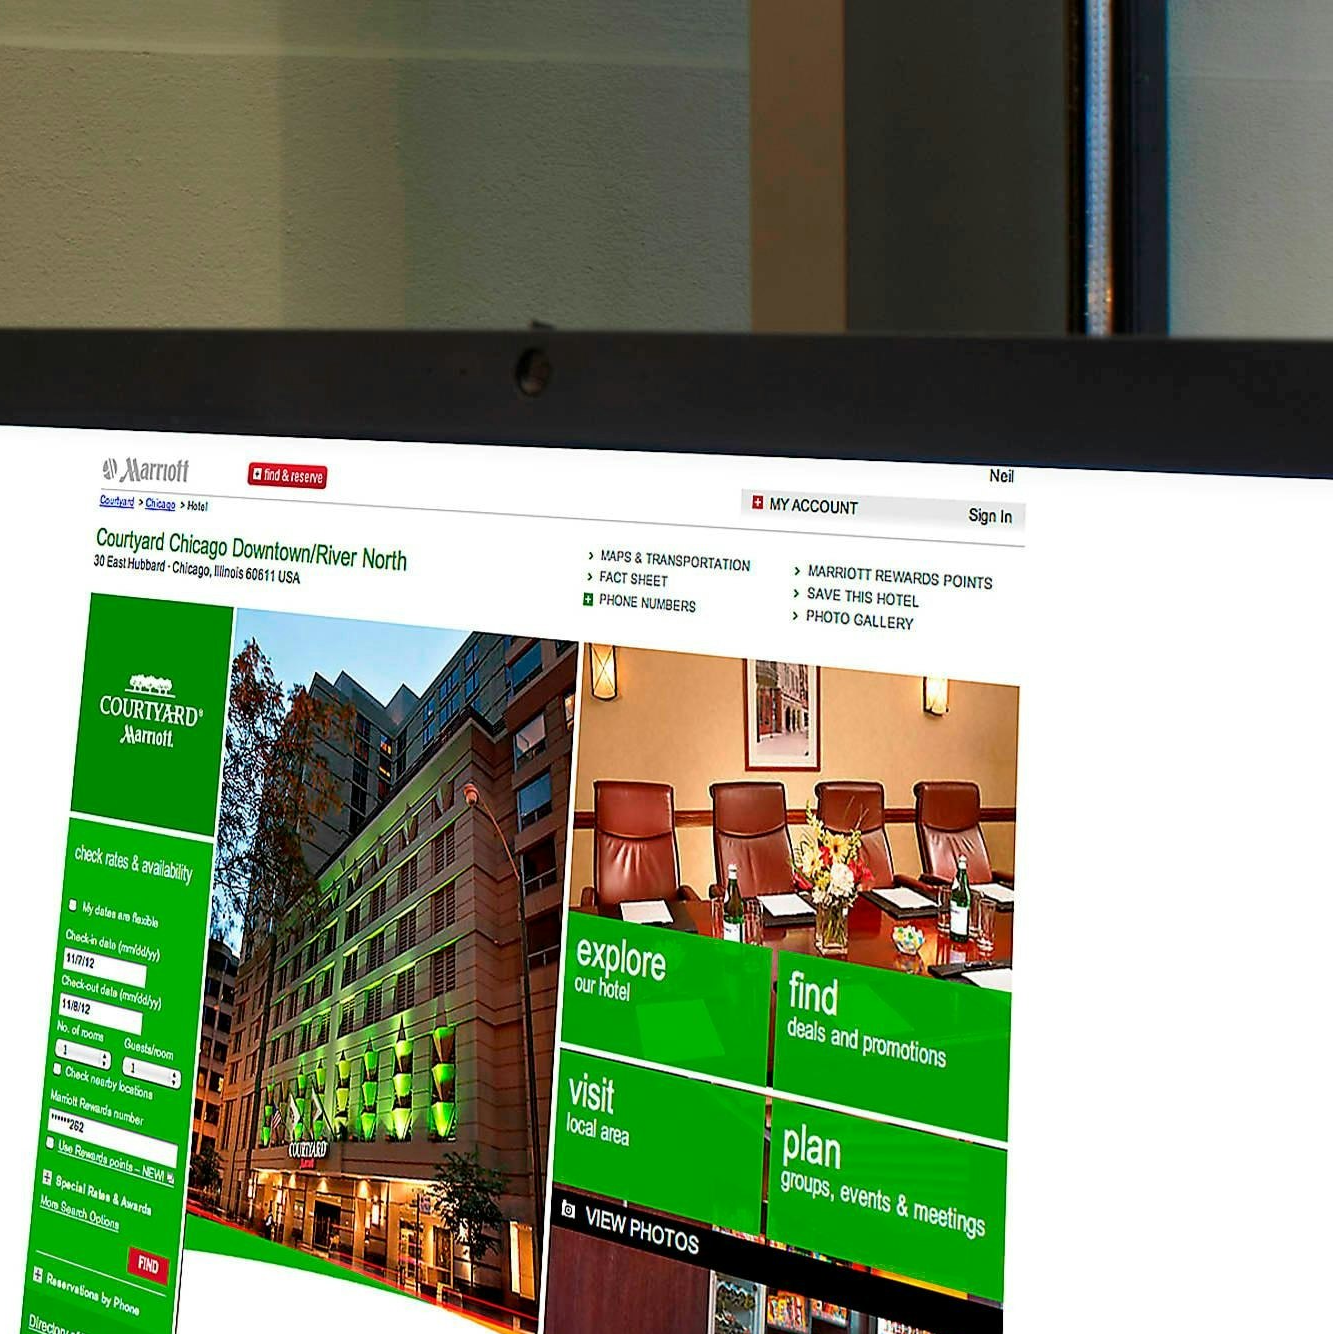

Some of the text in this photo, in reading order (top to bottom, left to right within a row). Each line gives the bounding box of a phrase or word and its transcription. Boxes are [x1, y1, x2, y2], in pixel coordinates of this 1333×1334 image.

[120, 457, 190, 483] Marriott
[262, 467, 324, 486] find & reserve
[99, 494, 209, 512] Courtyard Chicago Hotel
[770, 497, 859, 515] MY ACCOUNT
[968, 507, 1012, 526] Sign In
[96, 527, 407, 572] Courtyard Chicago Downtown/River North
[600, 549, 632, 563] MAPS
[646, 552, 751, 572] TRANSPORTATION
[93, 553, 301, 585] 30 East Hubbard Chicago, Illinois 60611 USA
[599, 570, 668, 587] FACT SHEET
[808, 564, 993, 590] MARRIOTT REWARDS POINTS
[599, 593, 696, 613] PHONE NUMBERS
[807, 586, 920, 608] SAVE THIS HOTEL
[806, 609, 914, 630] PHOTO GALLERY
[119, 724, 174, 748] Marriott
[74, 844, 104, 865] check
[104, 851, 129, 870] rates
[141, 859, 194, 886] availability
[82, 901, 159, 929] My dates are flexible
[66, 952, 95, 969] 11/7/12
[576, 938, 666, 986] explore
[574, 976, 631, 1002] our hotel
[788, 970, 838, 1016] find
[62, 998, 91, 1015] 11/8/12
[787, 1016, 946, 1068] deals and promotions
[568, 1072, 615, 1115] visit
[566, 1111, 630, 1147] local area
[783, 1123, 841, 1170] plan
[55, 1174, 86, 1195] Special
[87, 1184, 111, 1203] Rates
[120, 1195, 152, 1217] Awards
[780, 1164, 986, 1240] groups, events & meetings
[39, 1192, 121, 1232] More Search Options
[585, 1205, 699, 1255] VIEW PHOTOS
[138, 1254, 159, 1274] FIND
[46, 1272, 140, 1316] Reservations by Phone
